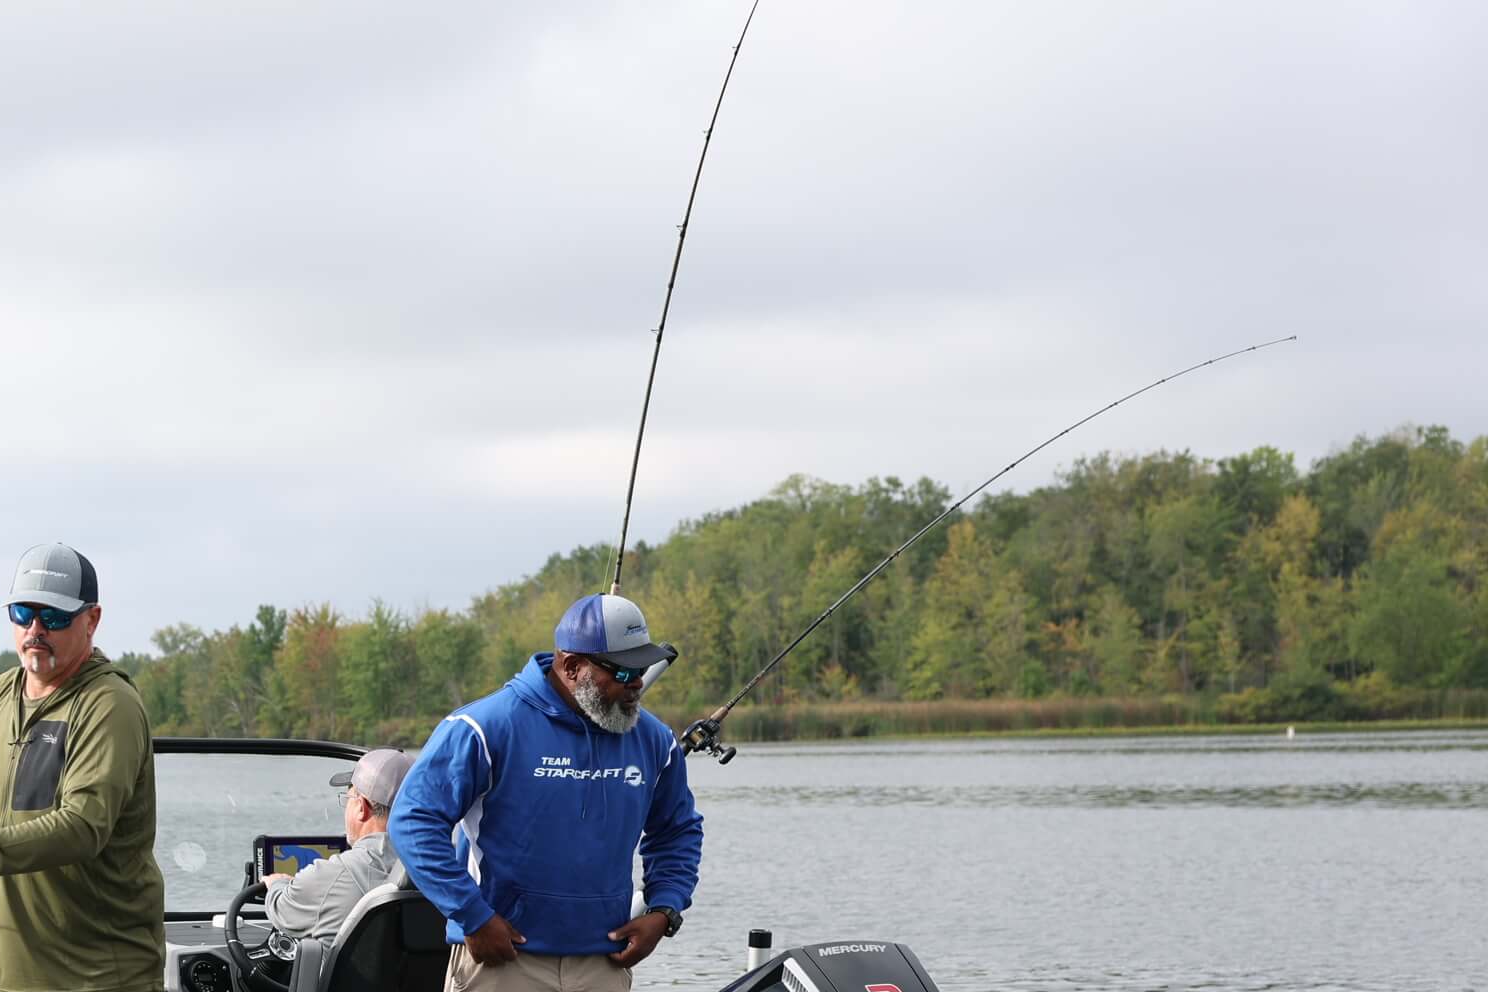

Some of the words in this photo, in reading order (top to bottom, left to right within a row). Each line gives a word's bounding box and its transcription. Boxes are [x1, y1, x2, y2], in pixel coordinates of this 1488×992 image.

[541, 756, 572, 767] TEAM
[533, 767, 624, 781] STARCRAFT
[818, 944, 887, 957] MERCURY
